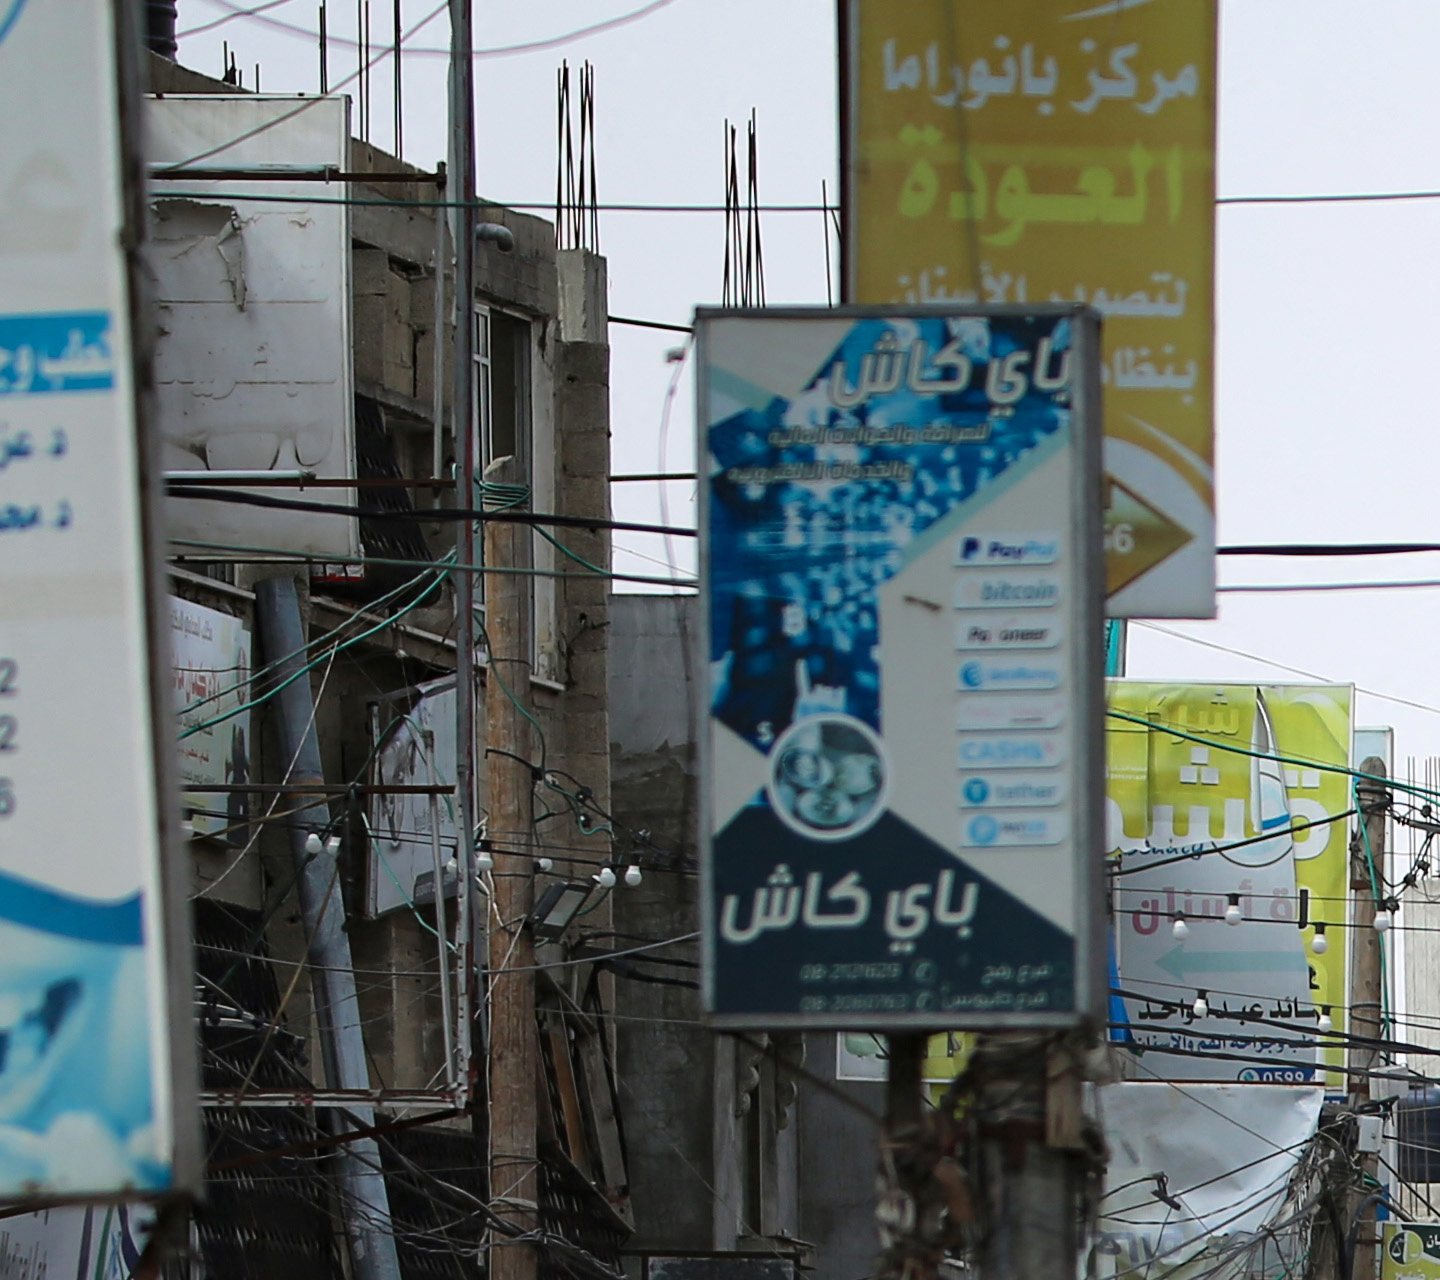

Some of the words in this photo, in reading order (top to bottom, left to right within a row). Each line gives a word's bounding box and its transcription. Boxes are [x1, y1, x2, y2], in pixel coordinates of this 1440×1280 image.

[882, 35, 1059, 116] بانوراما
[1068, 37, 1200, 115] مركز
[898, 124, 1185, 246] العودة
[829, 330, 974, 410] كاش
[983, 335, 1072, 420] باي
[967, 624, 1049, 643] Paoneer
[720, 863, 873, 943] كاش
[884, 868, 981, 955] باي
